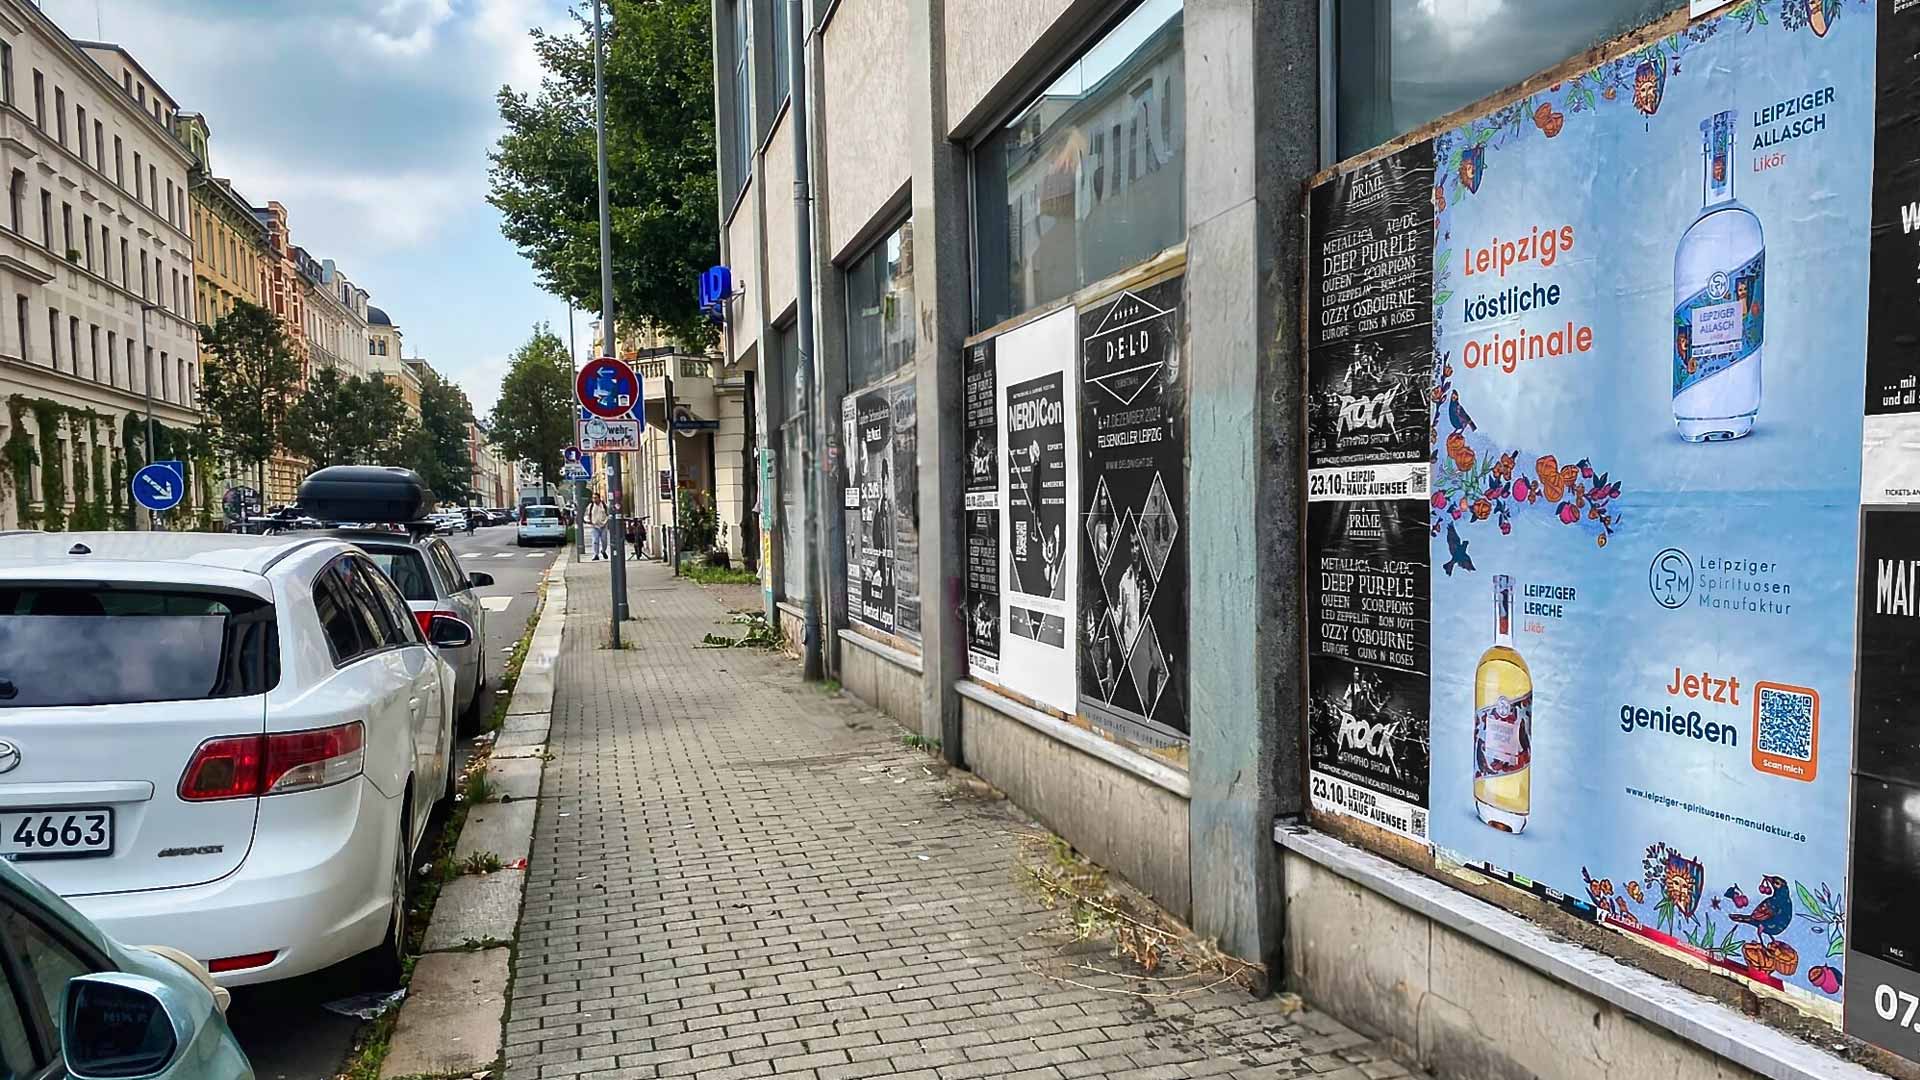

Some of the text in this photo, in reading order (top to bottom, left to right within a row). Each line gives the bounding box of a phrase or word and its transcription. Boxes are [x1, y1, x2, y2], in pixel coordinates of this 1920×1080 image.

[1753, 86, 1835, 127] LEIPZIGER
[1753, 113, 1826, 150] ALLASCH
[1753, 152, 1786, 172] Likör
[1352, 174, 1385, 200] PRIME
[1322, 212, 1418, 256] METALLICA AC/DC
[1322, 230, 1417, 277] DEEP PURPLE
[1465, 225, 1574, 277] Leipzigs
[1322, 254, 1416, 293] QUEEN SCORPIONS
[1321, 287, 1416, 326] OZZY OSBOURNE
[1322, 293, 1336, 307] LED
[1464, 282, 1561, 323] köstliche
[1322, 325, 1349, 342] EUROPE
[1390, 309, 1415, 327] ROSES
[1463, 321, 1592, 374] Originale
[1883, 391, 1901, 405] und
[1904, 390, 1916, 404] all
[1009, 397, 1062, 432] NERDICon
[1097, 427, 1162, 448] FELSENKELLER LEIPZIG
[1346, 470, 1376, 483] LEIPZIG
[1346, 481, 1408, 496] HAUS AUENSEE
[1349, 514, 1381, 528] PRIME
[1321, 557, 1414, 575] METALLICA AC/DC
[1700, 555, 1777, 576] Leipziger
[1321, 573, 1414, 598] DEEP PURPLE
[1524, 583, 1576, 601] LEIPZIGER
[1700, 574, 1791, 595] Spirituosen
[1321, 594, 1414, 616] QUEEN SCORPIONS
[1524, 602, 1563, 618] LERCHE
[1700, 594, 1791, 615] Manufaktur
[1321, 609, 1336, 620] LED
[1336, 610, 1369, 625] ZEPPELIN
[1378, 615, 1394, 628] BON
[1321, 623, 1414, 651] OZZY OSBOURNE
[1322, 641, 1414, 667] EUROPE GUNS N ROSES
[1667, 667, 1740, 706] Jetzt
[1620, 704, 1737, 746] genießen
[1337, 712, 1400, 768] ROCK
[1312, 776, 1347, 808] 23.10.
[1348, 787, 1376, 807] LEIPZIG
[1348, 801, 1407, 832] HAUS AUENSEE
[1625, 786, 1807, 842] www.leipziger-spirituosen-manufaktur.de
[13, 814, 105, 847] 4663
